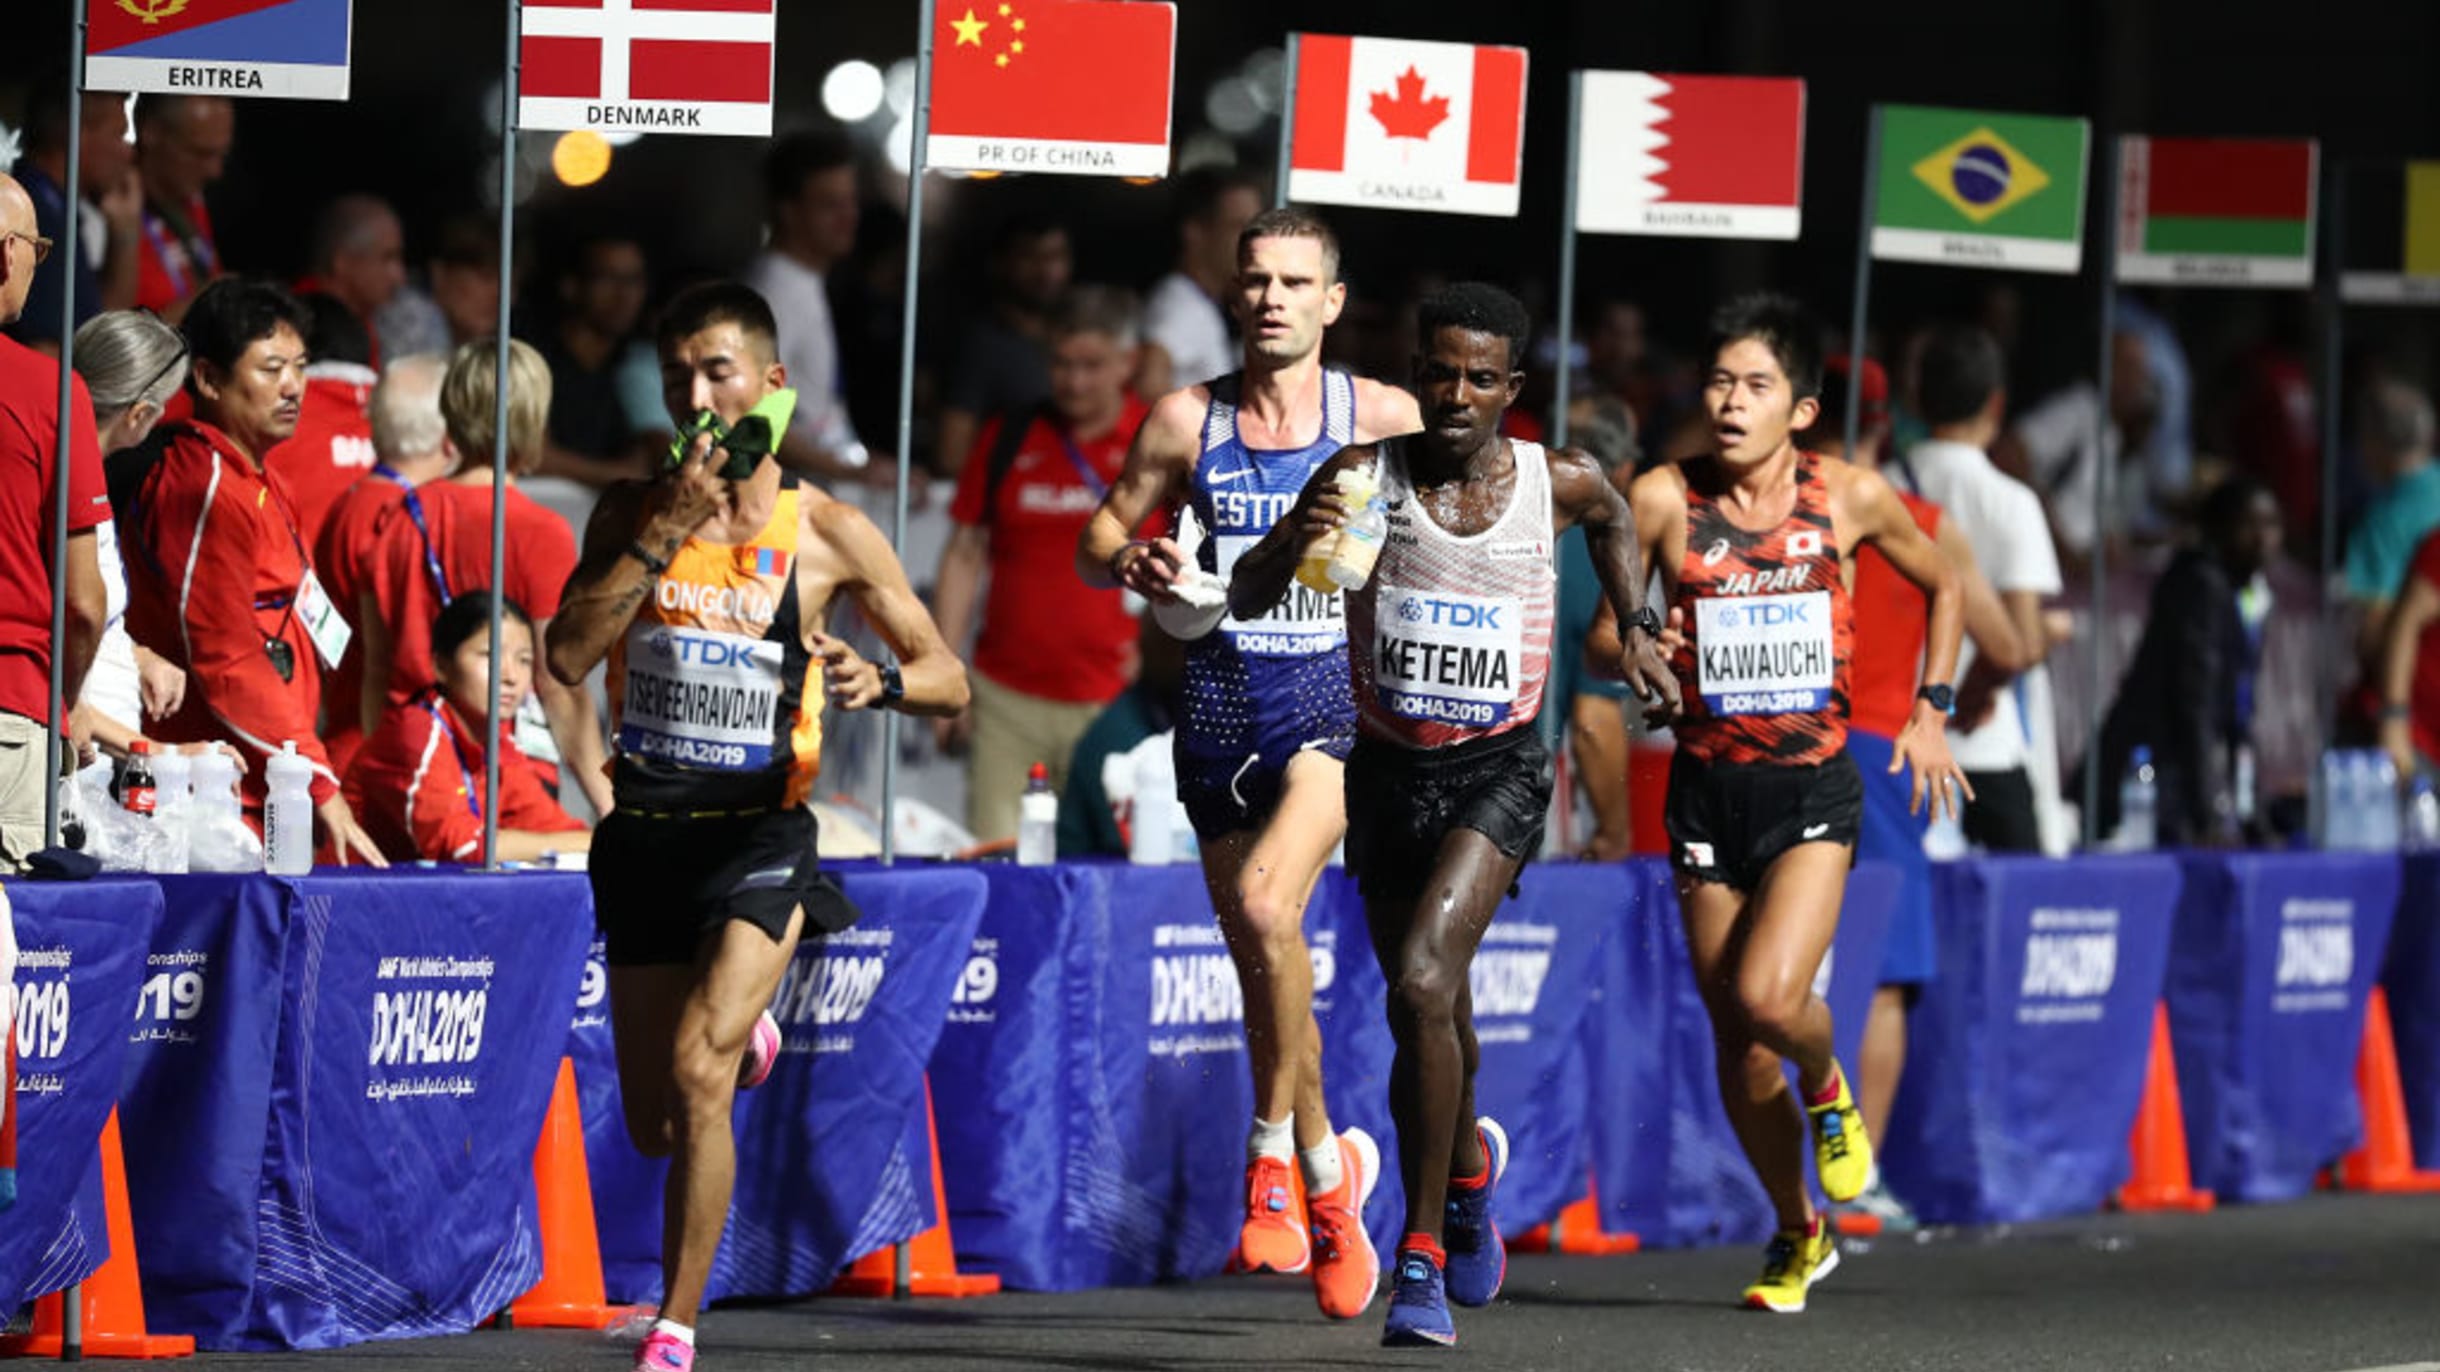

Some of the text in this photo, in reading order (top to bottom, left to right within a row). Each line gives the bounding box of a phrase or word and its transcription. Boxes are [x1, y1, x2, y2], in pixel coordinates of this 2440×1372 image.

[168, 67, 263, 89] ERITREA
[587, 105, 701, 126] DENMARK
[978, 144, 1115, 167] PR OF CHINA
[1358, 181, 1446, 201] CANADA
[1715, 563, 1813, 596] JAPAN
[653, 578, 774, 625] ONGOLIA
[1271, 585, 1343, 631] RME
[1424, 599, 1502, 629] TDK
[1740, 602, 1809, 627] TDK
[673, 635, 755, 669] TDK
[1237, 633, 1334, 653] DOHA2019
[1381, 634, 1510, 690] KETEMA
[1703, 639, 1827, 682] KAWAUCHI
[628, 670, 771, 731] TSEVEENRAVDAN
[1391, 695, 1495, 723] DOHA2019
[1721, 691, 1816, 714] DOHA2019
[640, 732, 747, 767] DOHA2019
[134, 970, 204, 1022] 19
[369, 990, 487, 1065] DOHA2019
